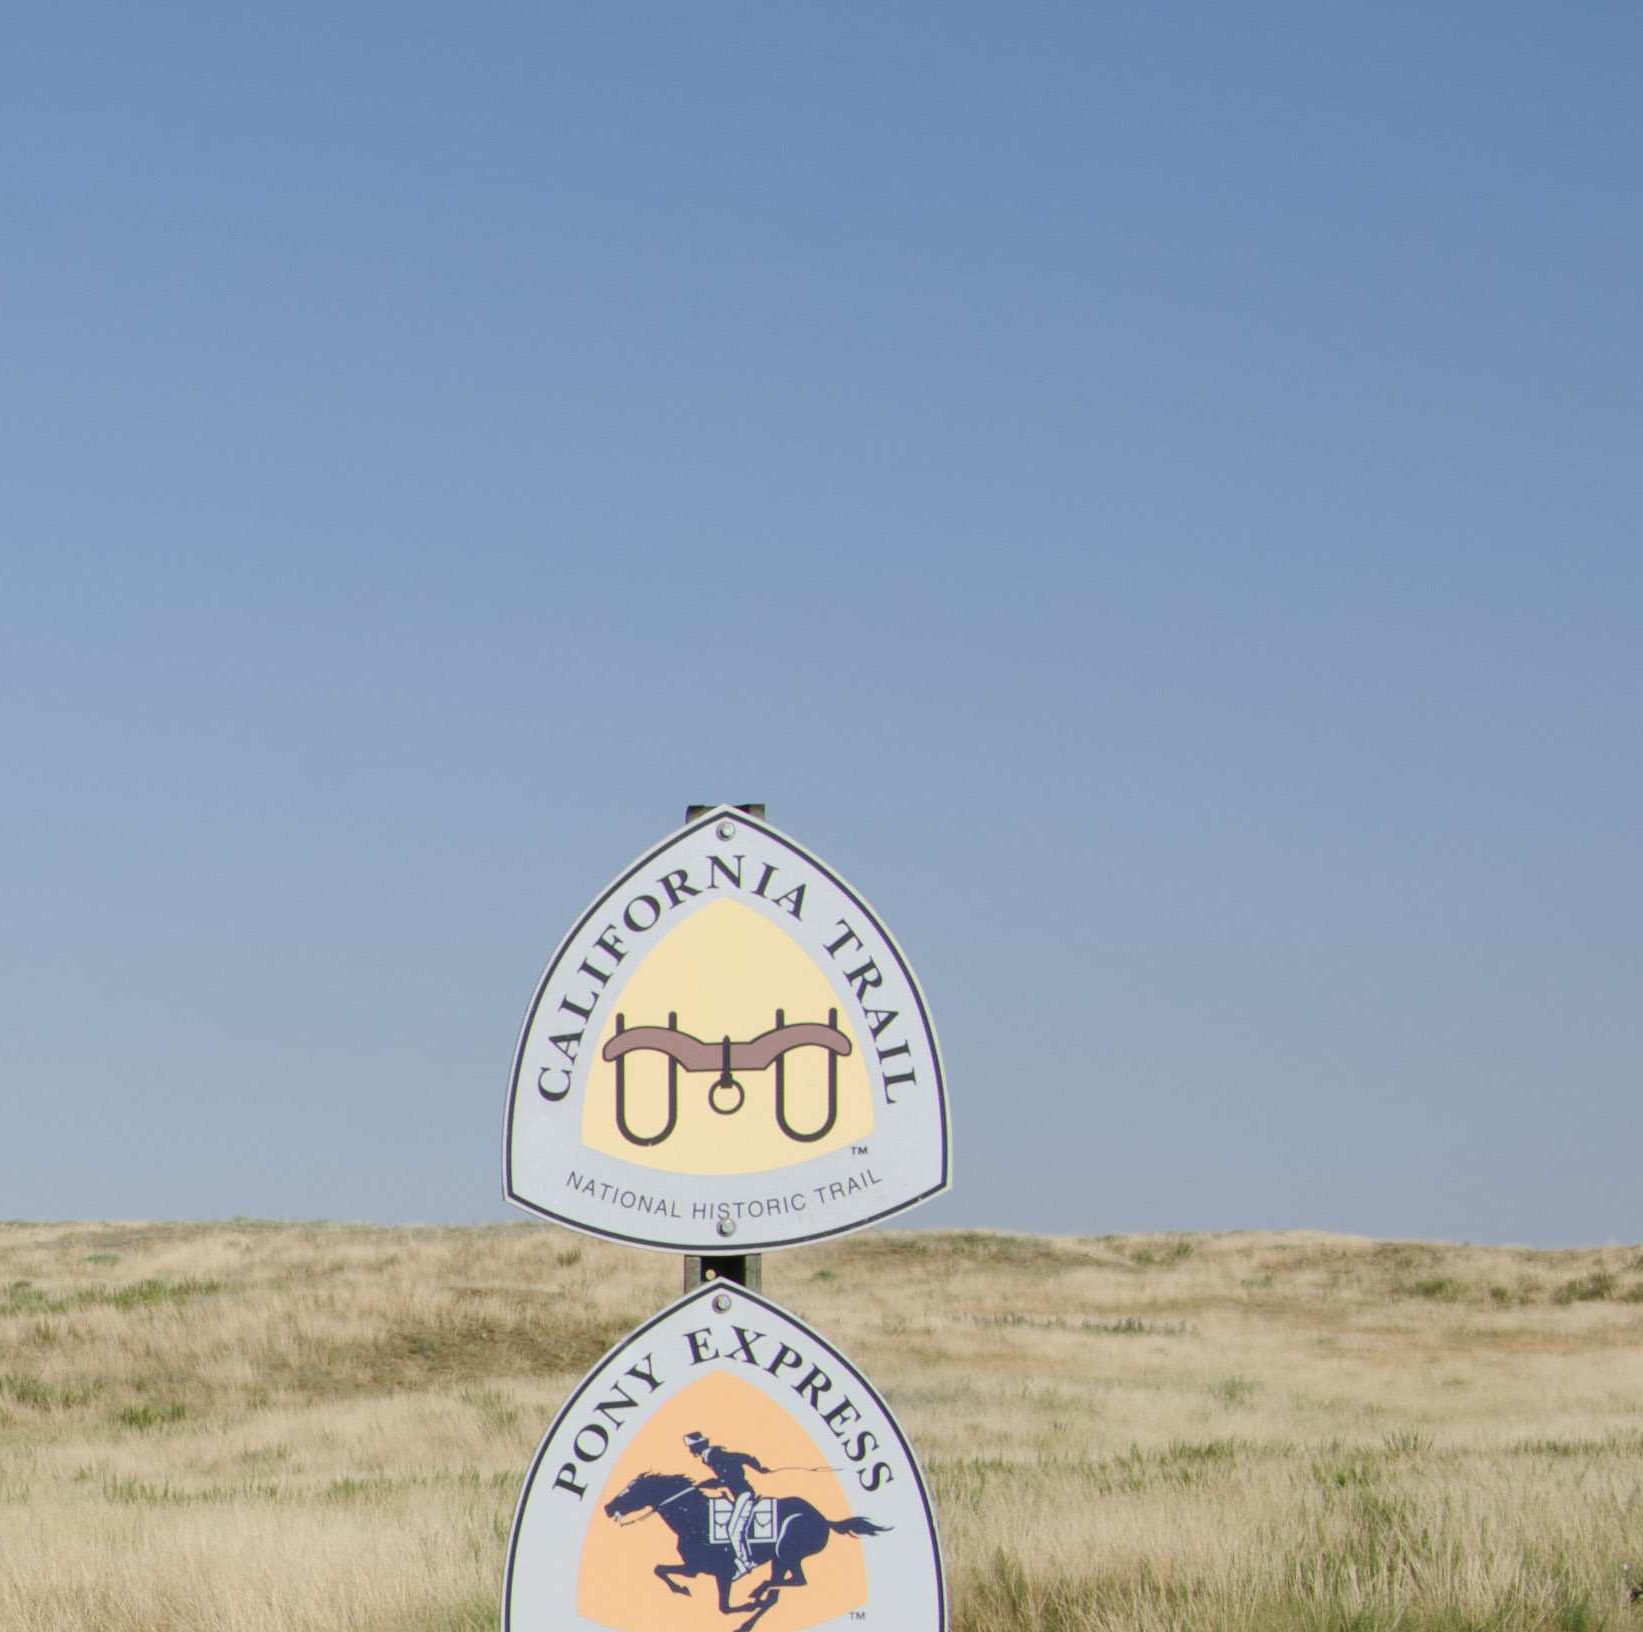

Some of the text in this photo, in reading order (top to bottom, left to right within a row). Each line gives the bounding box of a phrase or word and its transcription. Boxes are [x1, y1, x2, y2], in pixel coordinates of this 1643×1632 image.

[537, 854, 917, 1105] CALIFORNIA TRAIL
[566, 1169, 883, 1220] NATIONAL HISTORIC TRAIL
[552, 1324, 895, 1501] PONY EXPRESS
